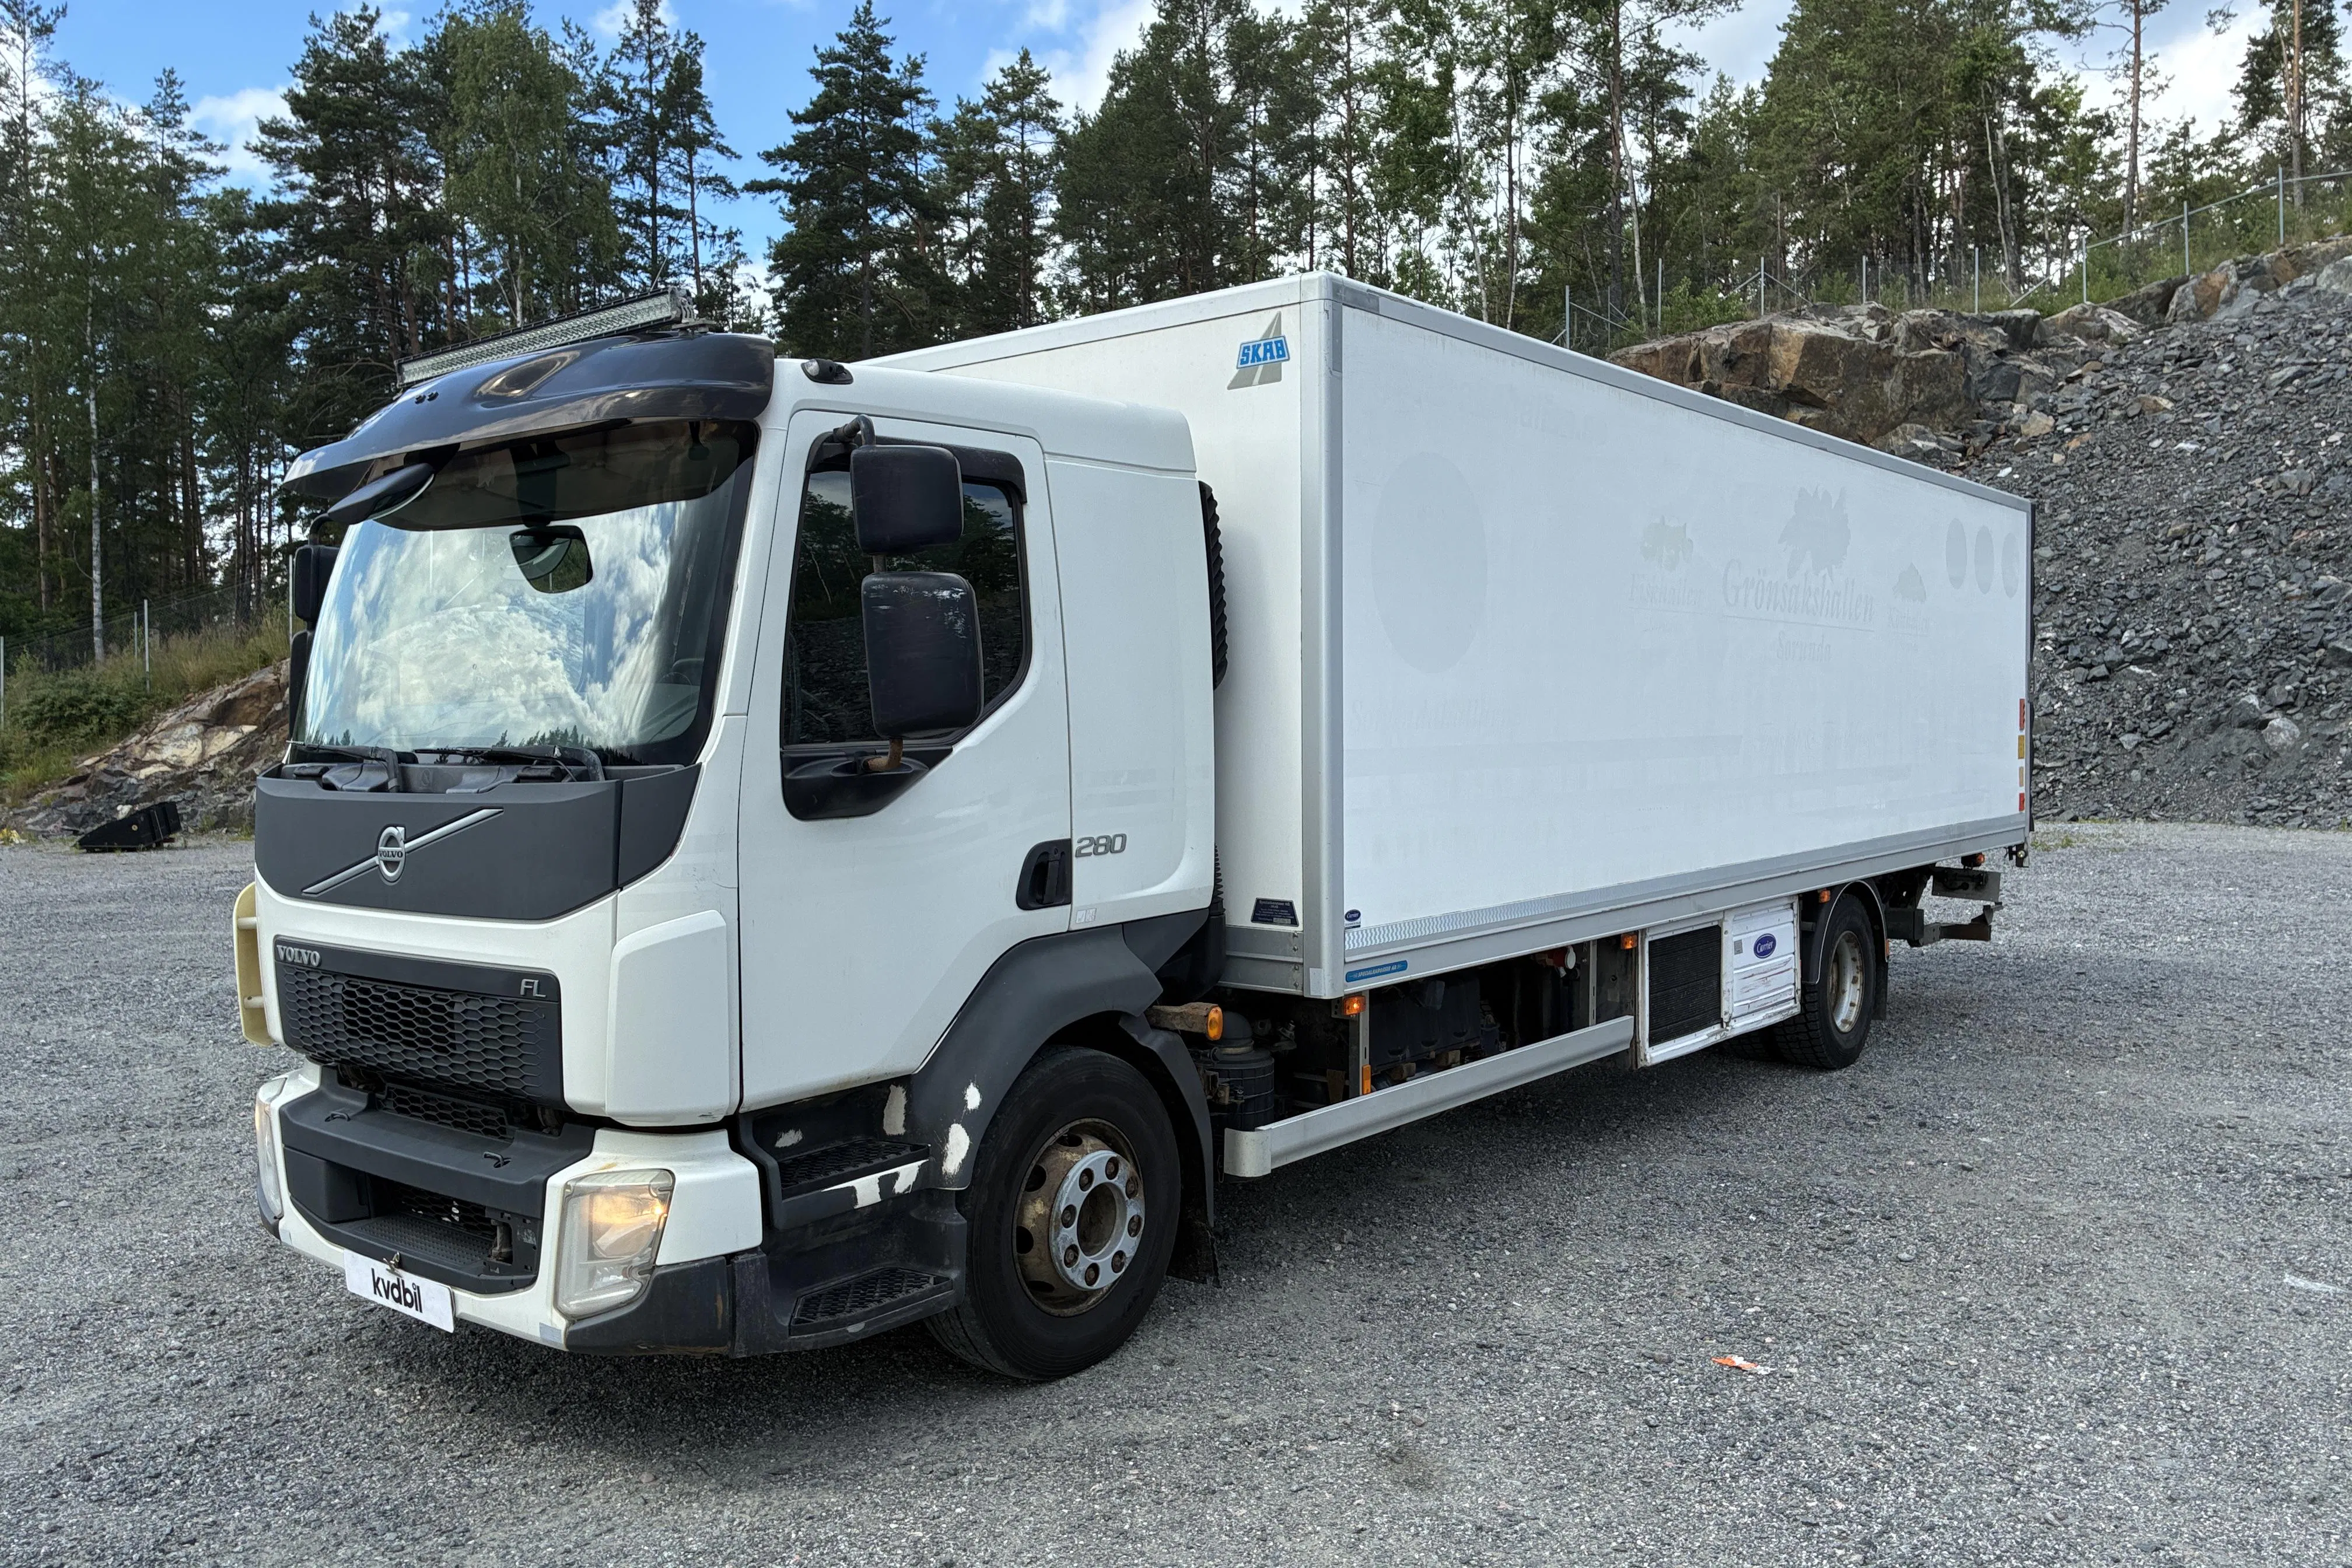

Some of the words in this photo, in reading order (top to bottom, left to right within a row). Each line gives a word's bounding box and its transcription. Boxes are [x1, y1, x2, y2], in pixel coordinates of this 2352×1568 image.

[1240, 339, 1286, 366] SKAB
[1721, 558, 1875, 622] Grönsakshallen
[378, 850, 403, 858] VOLVO
[1075, 833, 1127, 858] 280
[276, 944, 321, 967] VOLVO
[1756, 940, 1773, 954] Carrier
[520, 978, 547, 998] FL
[371, 1267, 423, 1314] kvdbil
